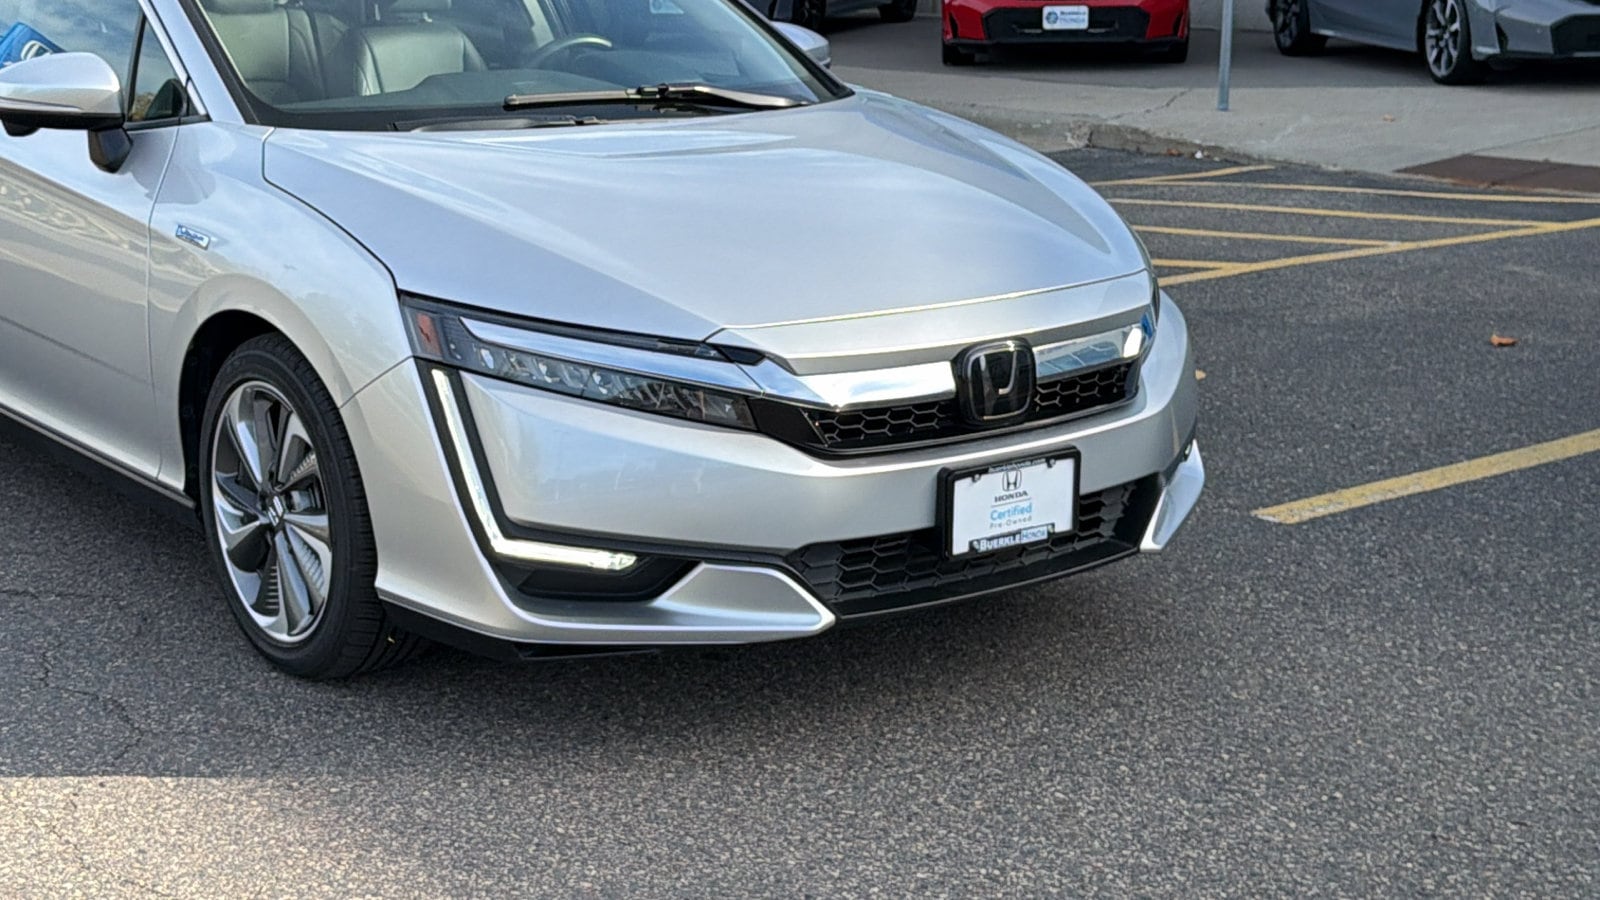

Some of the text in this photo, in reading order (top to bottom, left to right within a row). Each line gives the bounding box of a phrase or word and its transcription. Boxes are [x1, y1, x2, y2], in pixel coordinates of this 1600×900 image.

[994, 490, 1028, 502] HONDA
[990, 502, 1032, 521] Certified
[990, 515, 1032, 529] Pre-Owned
